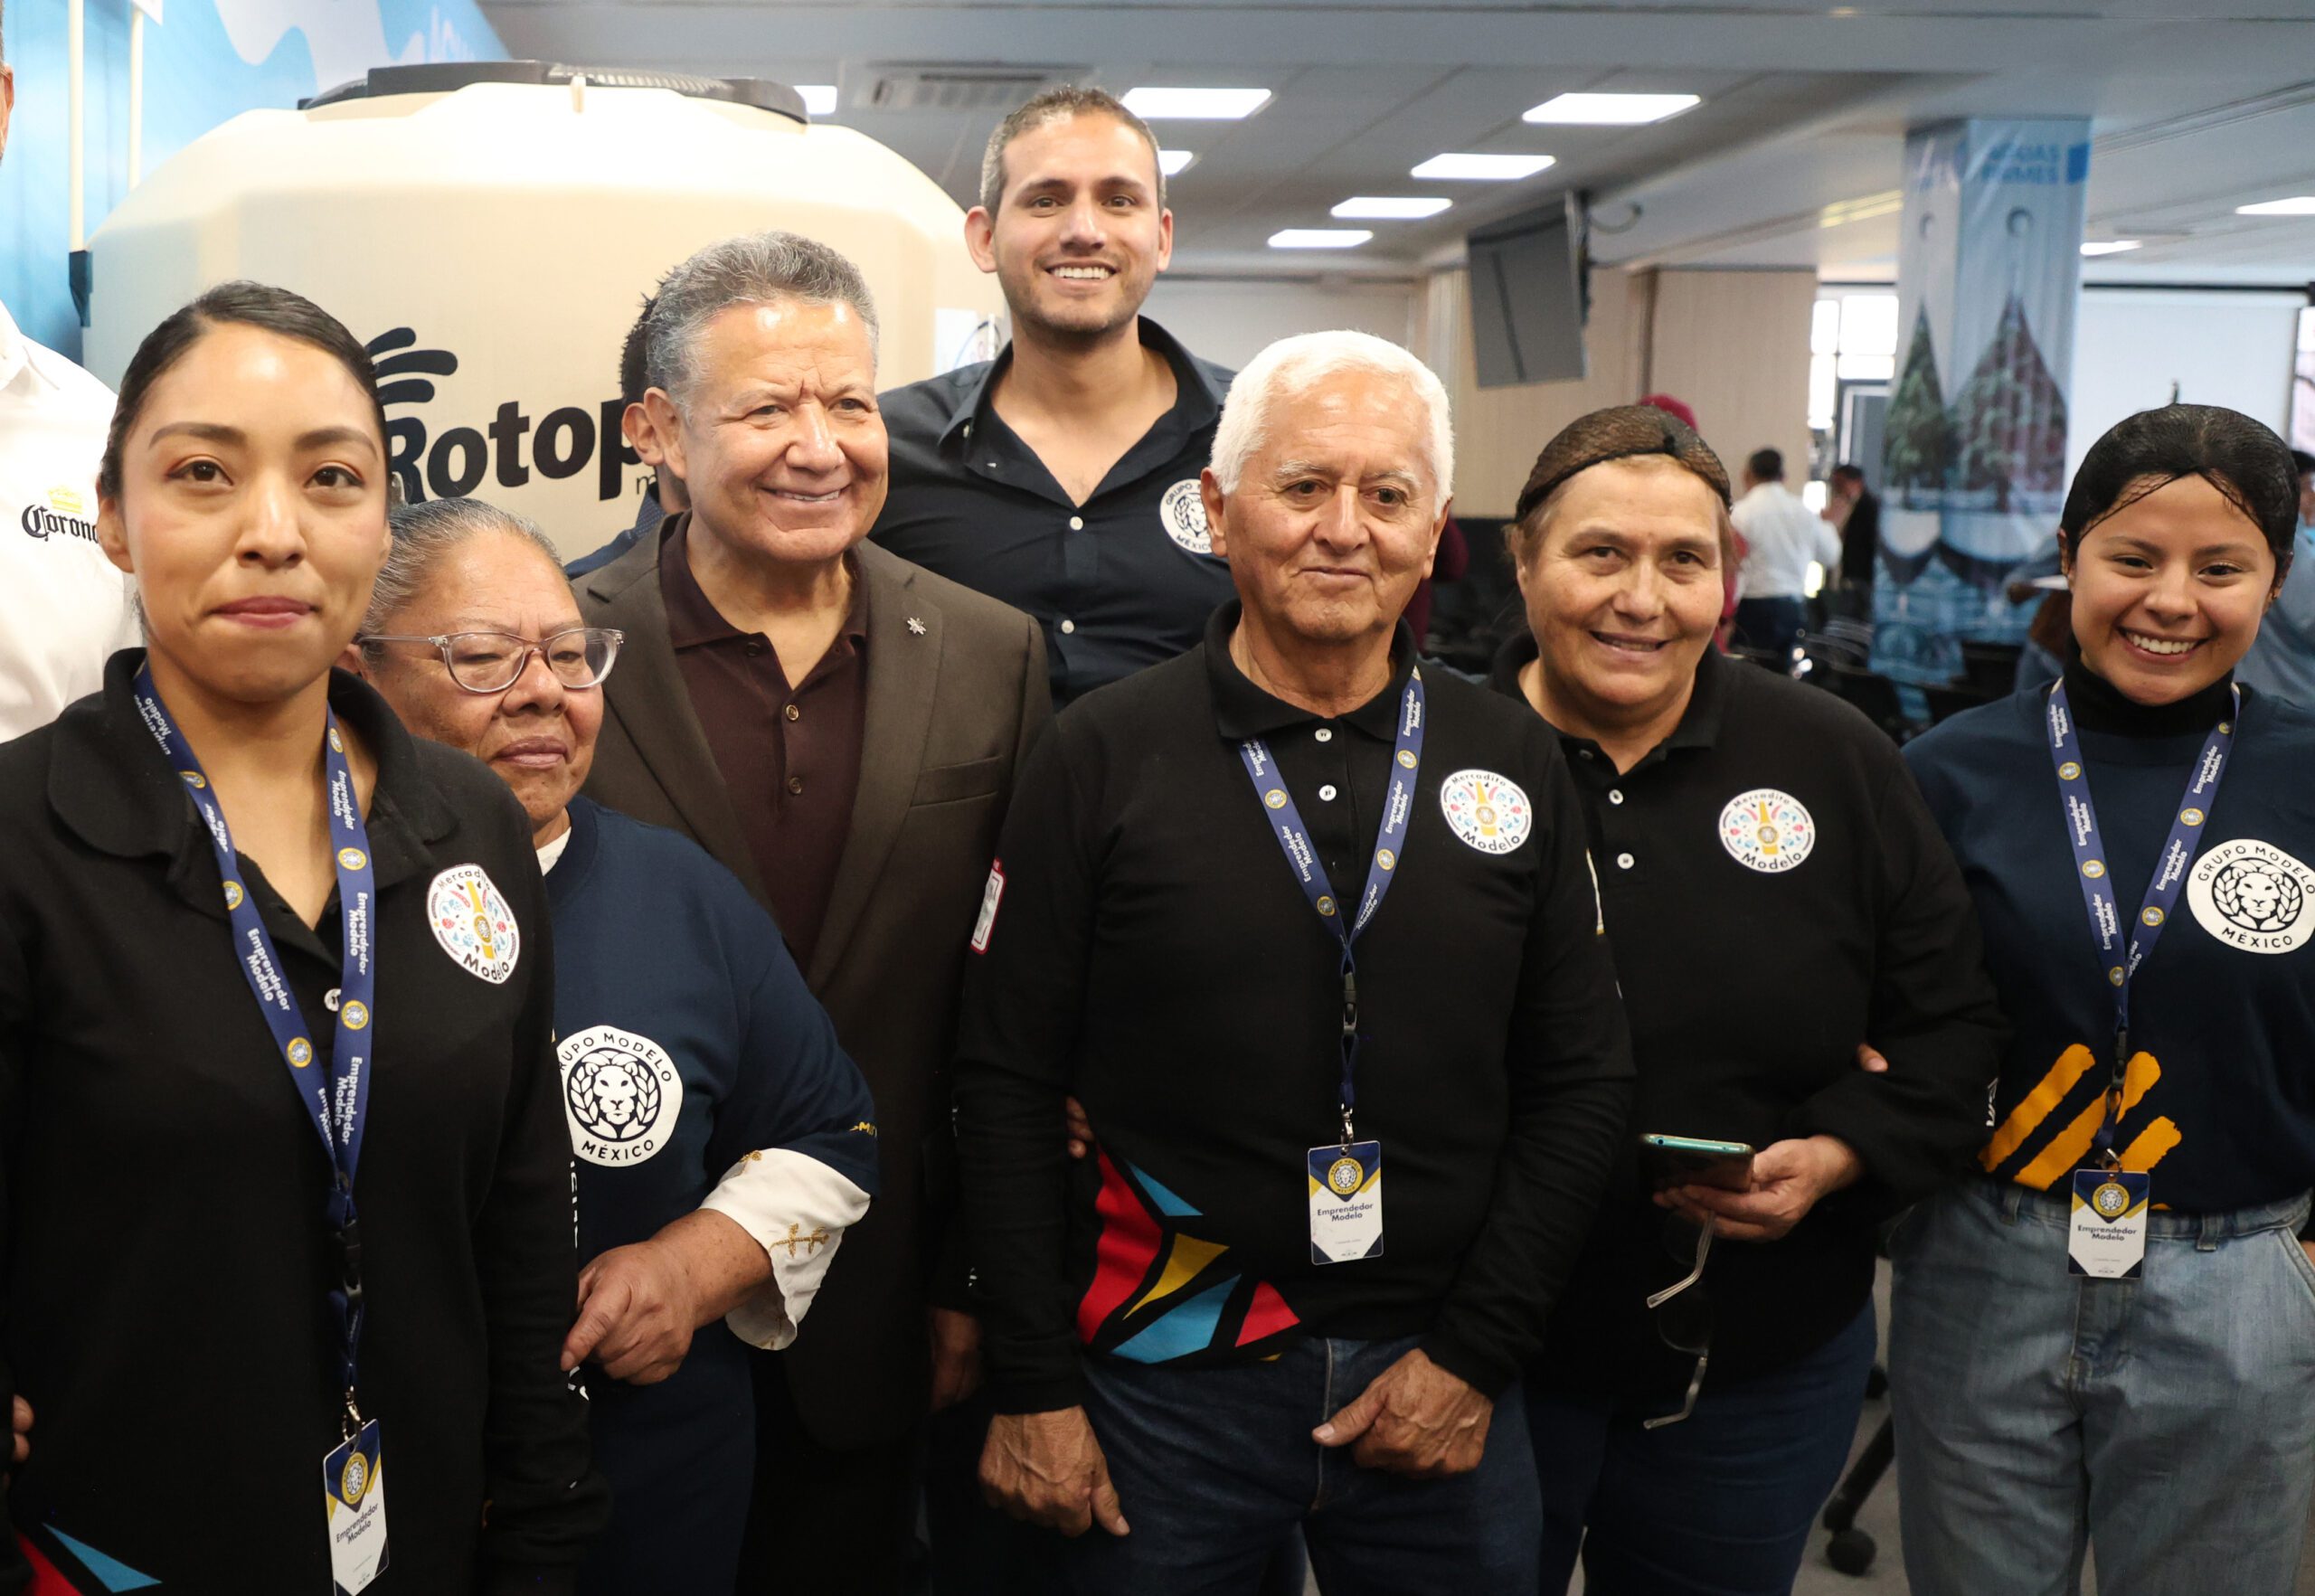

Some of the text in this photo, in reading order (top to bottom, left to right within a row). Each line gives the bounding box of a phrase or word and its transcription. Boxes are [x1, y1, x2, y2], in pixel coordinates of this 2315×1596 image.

[386, 398, 641, 504] Rotop
[1166, 483, 1193, 505] GRUPO
[1176, 534, 1211, 551] MÉXIC
[145, 697, 172, 736] Modelo
[1451, 773, 1506, 787] Mercadito
[2192, 745, 2218, 794] Emprendedor
[2206, 753, 2223, 783] Modelo
[332, 779, 345, 817] Modelo
[337, 770, 355, 830] Emprendedor
[1384, 779, 1403, 835] Emprendedor
[1396, 793, 1409, 825] Modelo
[2080, 802, 2093, 832] Modelo
[1281, 825, 1311, 883] Emprendedor
[1295, 832, 1313, 864] Modelo
[1462, 831, 1520, 851] Modelo
[1741, 853, 1802, 870] Modelo
[2155, 838, 2182, 891] Emprendedor
[2169, 851, 2187, 882] Modelo
[2197, 845, 2315, 894] GRUPO MODELO
[437, 869, 491, 891] Mercad
[348, 909, 361, 958] Modelo
[357, 892, 370, 976] Emprendedor
[2093, 892, 2112, 950] Emprendedor
[2104, 902, 2117, 934] Modelo
[2221, 927, 2292, 949] MÉXICO
[246, 954, 274, 1002] Modelo
[247, 928, 290, 1011] Emprendedor
[559, 1033, 672, 1082] RUPO MODELO
[334, 1076, 349, 1127] Modelo
[342, 1056, 363, 1146] Emprendedor
[581, 1139, 655, 1161] MÉXICO
[1317, 1203, 1374, 1216] Emprendedor
[1331, 1213, 1363, 1223] Modelo
[2077, 1224, 2138, 1235] Emprendedor
[2092, 1233, 2125, 1242] Modelo
[335, 1503, 379, 1544] Emprendedor
[347, 1520, 372, 1544] Modelo
